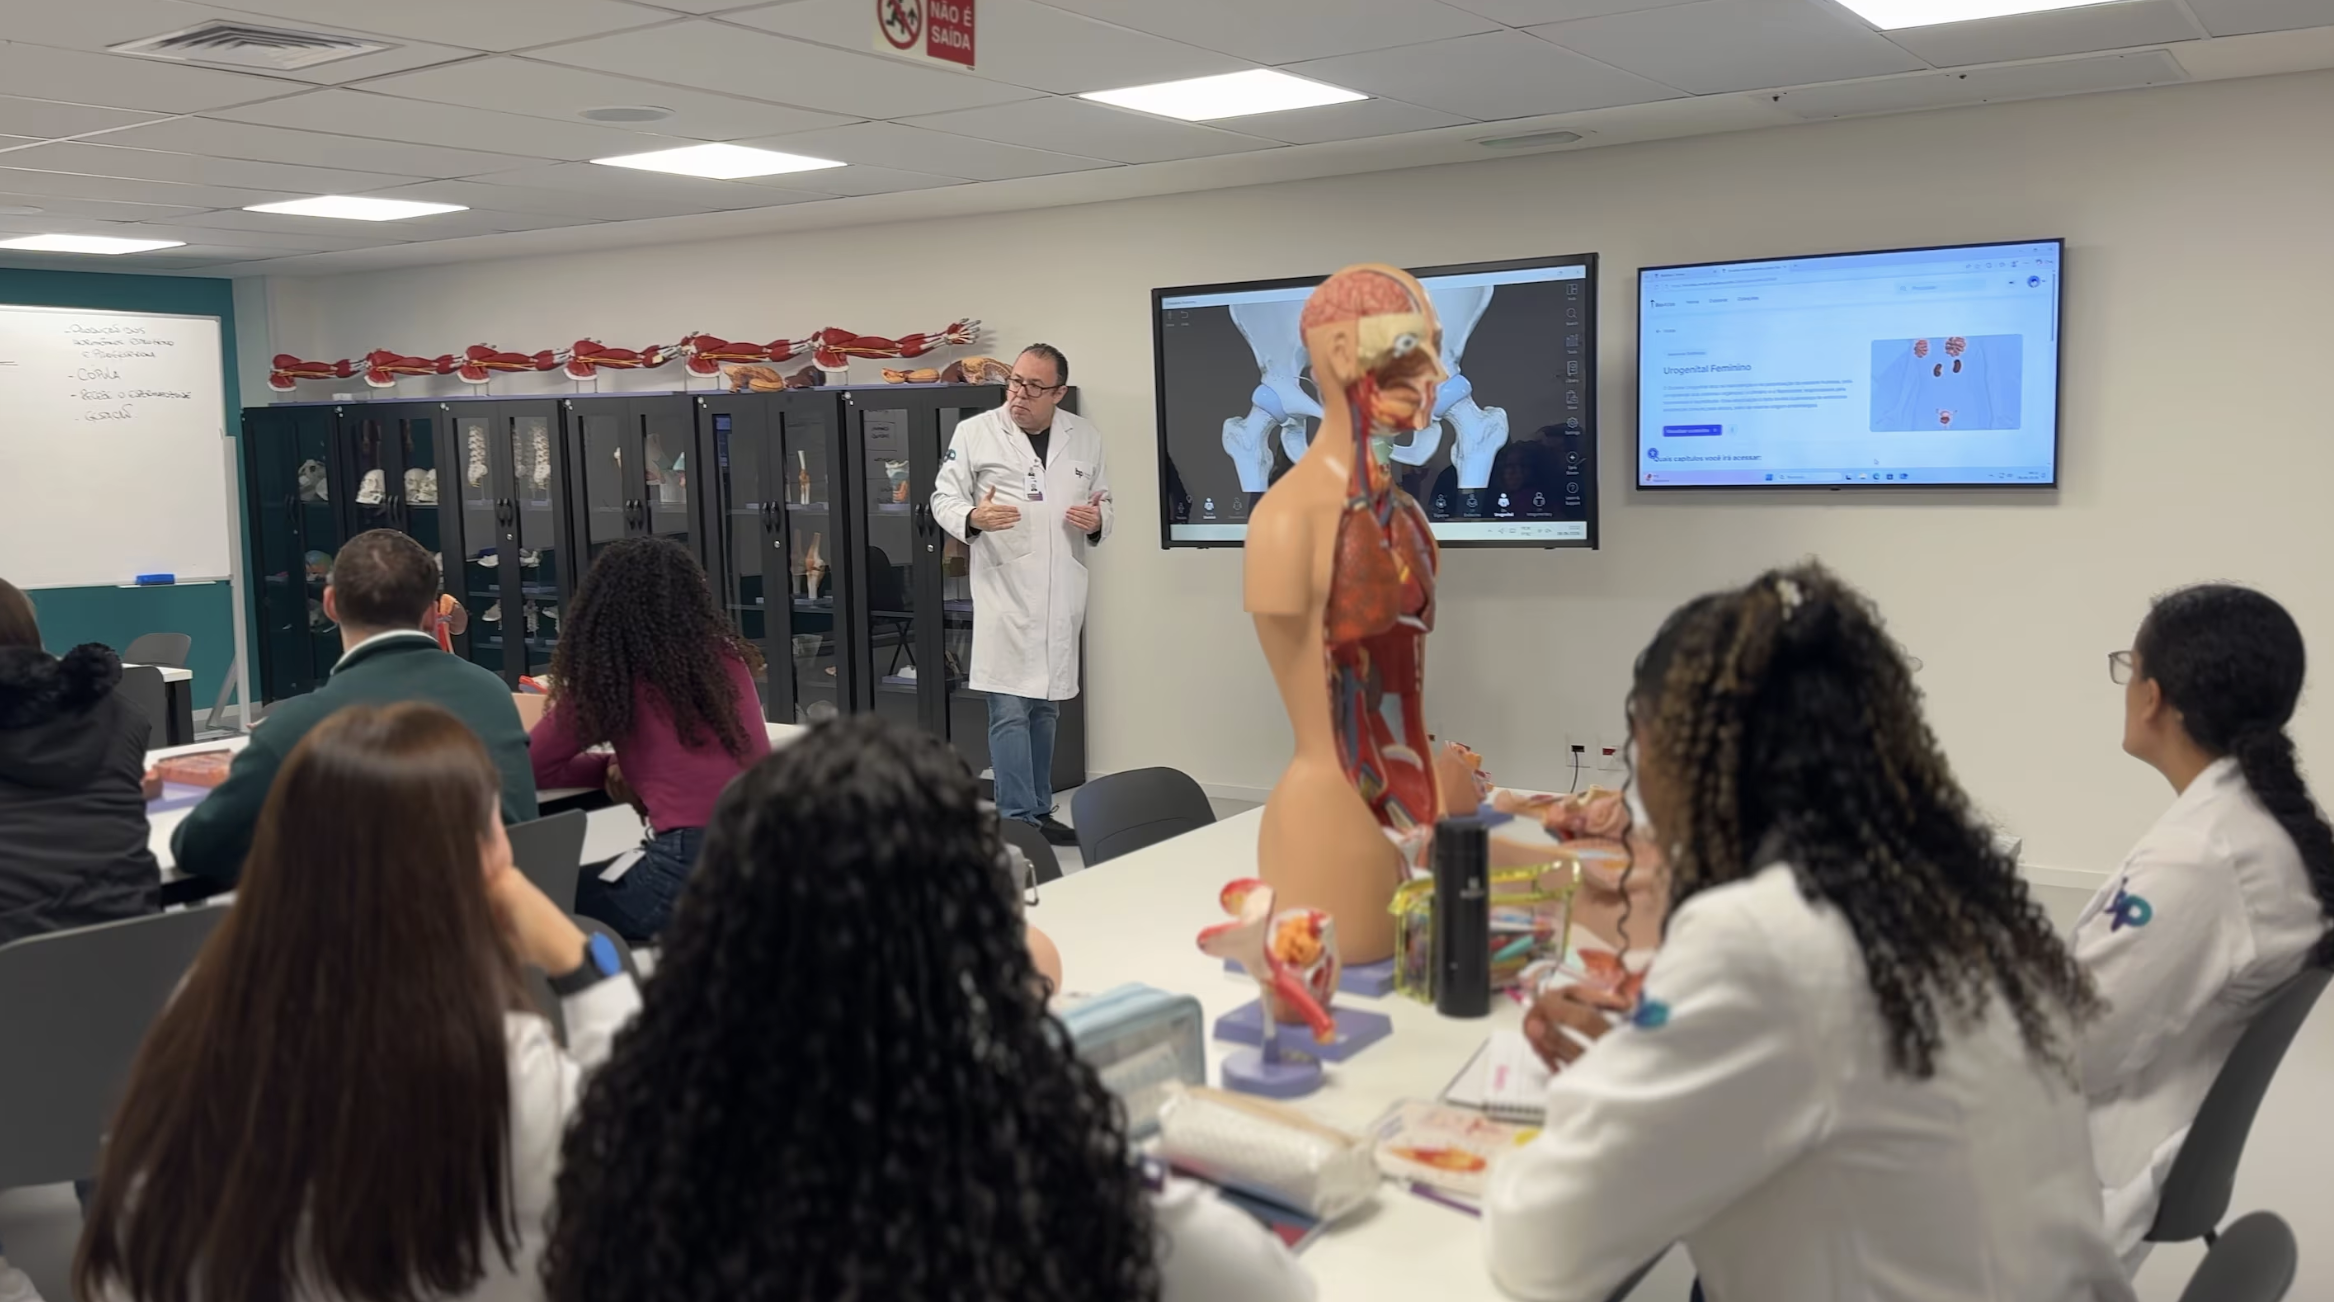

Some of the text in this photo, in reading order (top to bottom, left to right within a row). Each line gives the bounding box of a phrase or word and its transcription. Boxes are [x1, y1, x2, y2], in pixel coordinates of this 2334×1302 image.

[930, 0, 972, 27] NÃO É
[931, 25, 971, 51] SAÍDA
[1663, 364, 1752, 375] Urogenital Feminino
